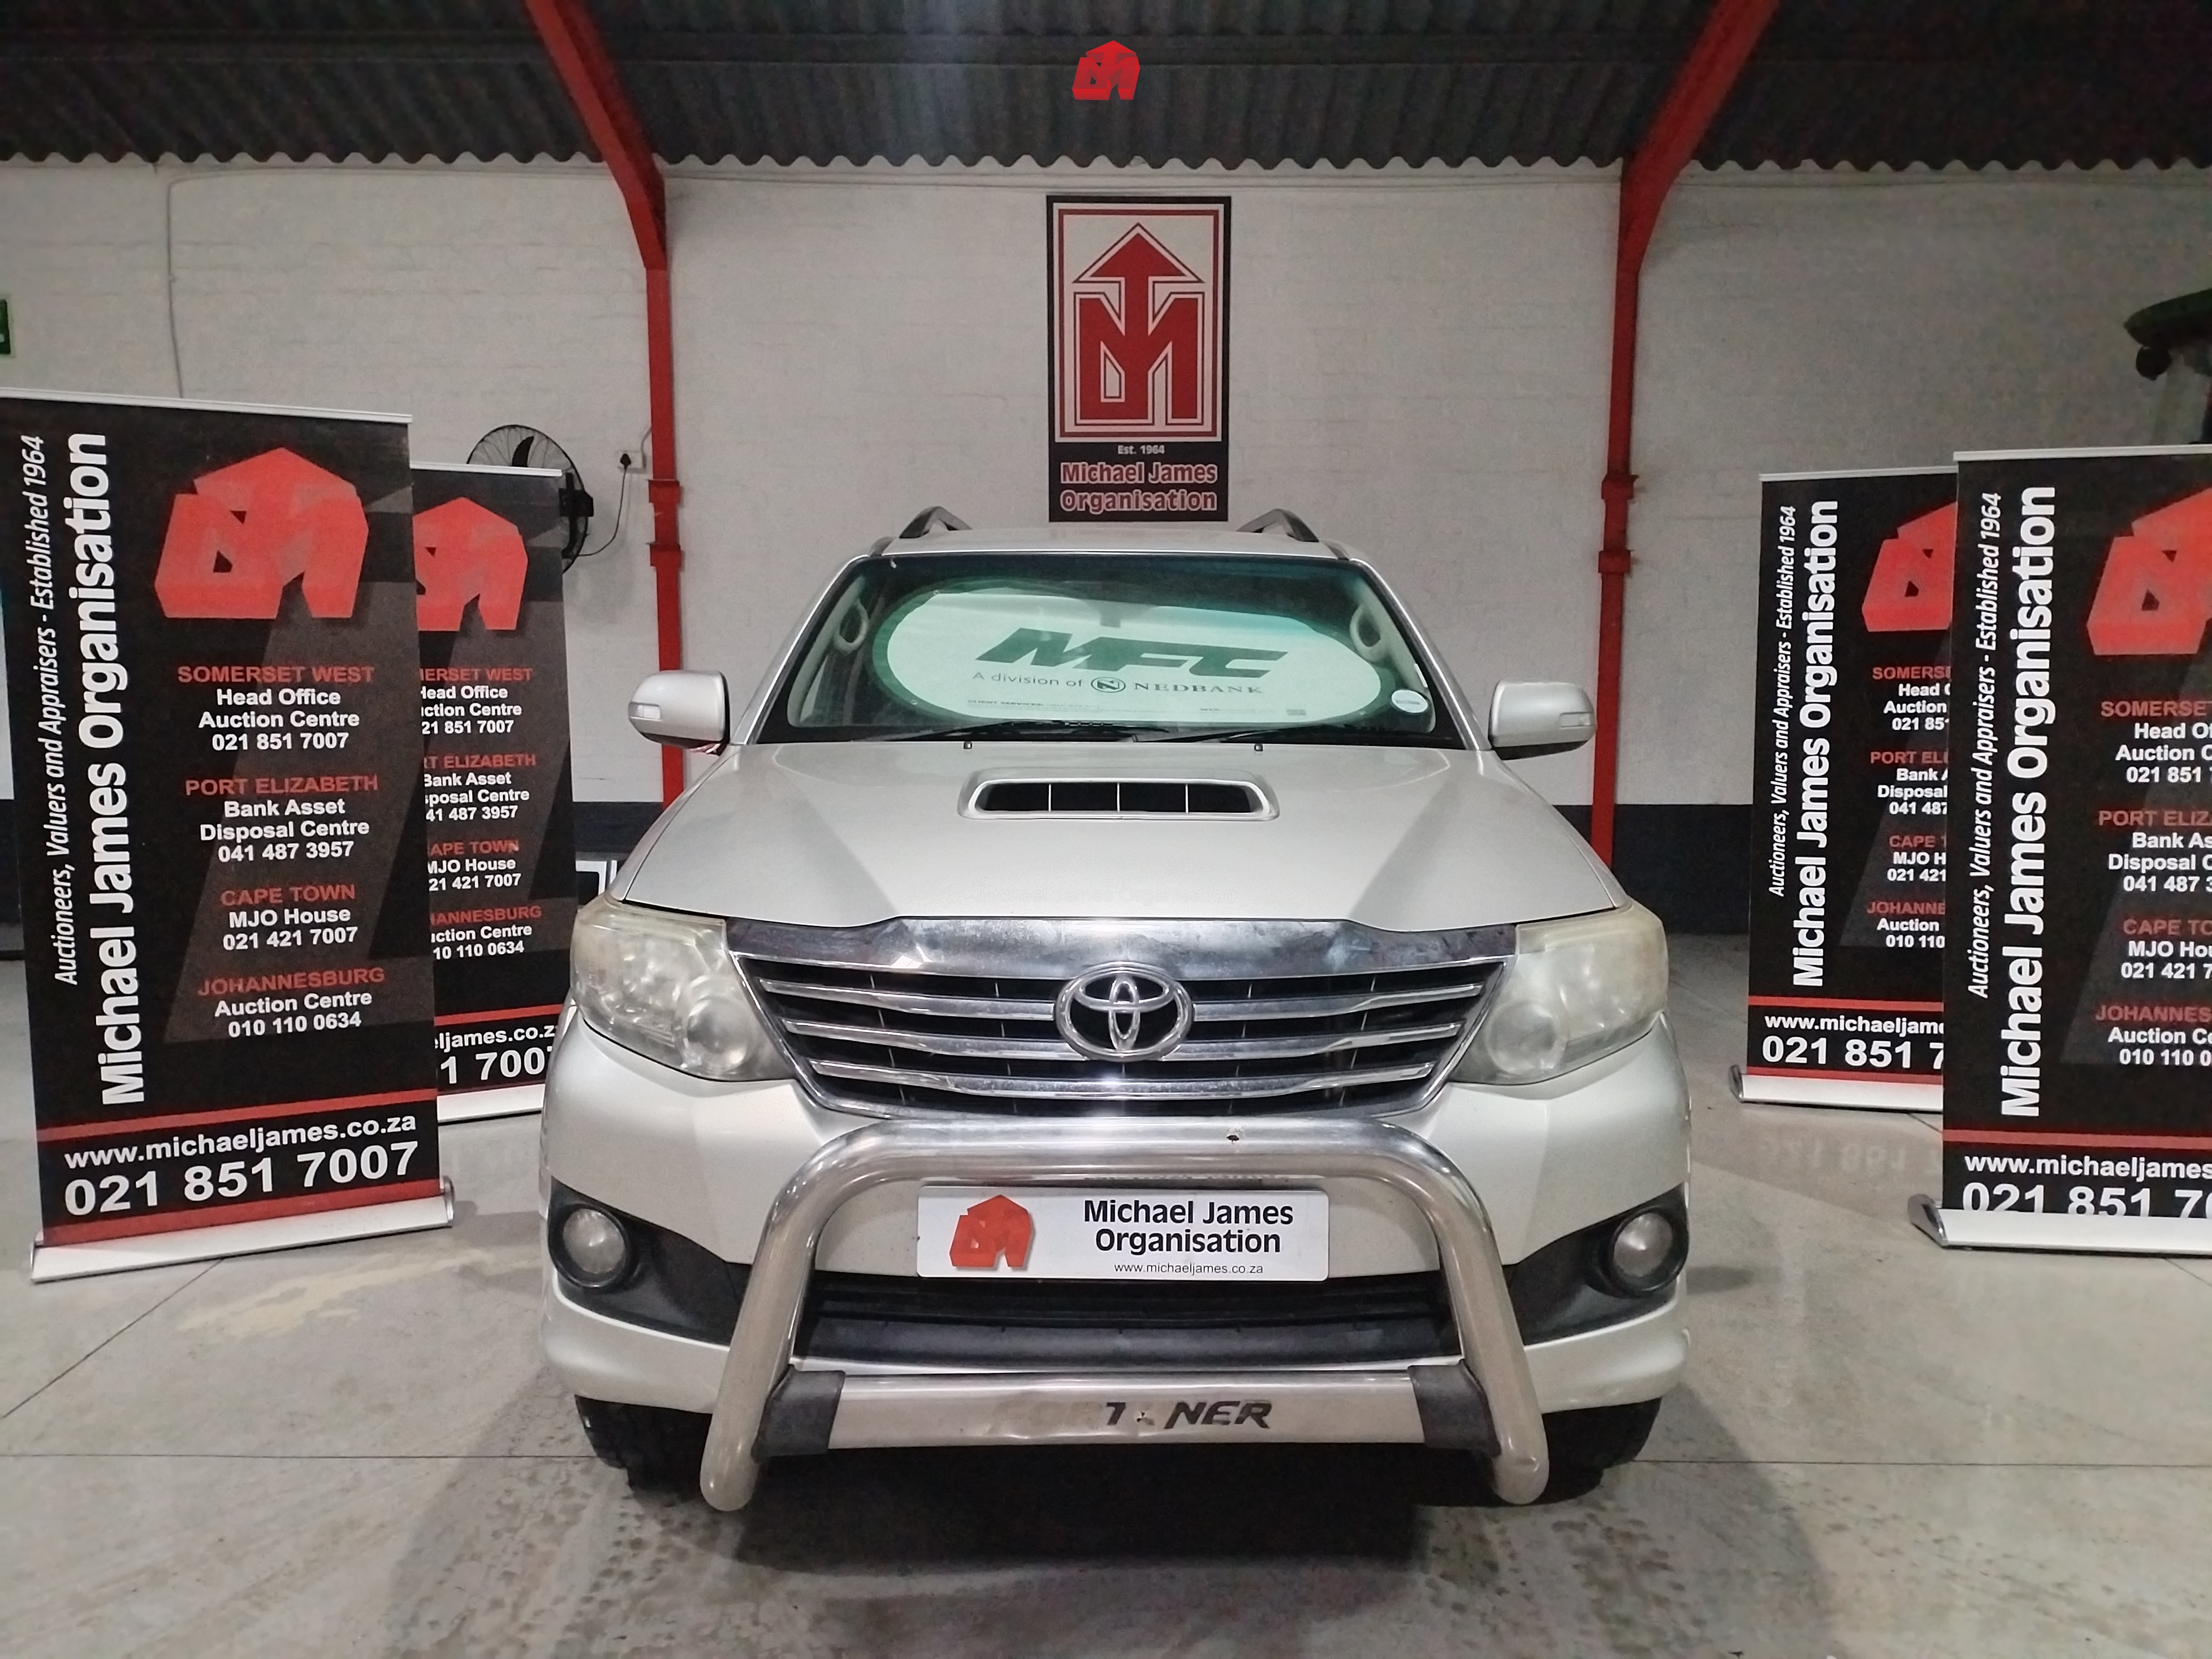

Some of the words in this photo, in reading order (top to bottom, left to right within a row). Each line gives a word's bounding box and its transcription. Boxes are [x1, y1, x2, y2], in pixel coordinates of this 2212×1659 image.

[1118, 446, 1136, 454] Est.
[1141, 445, 1164, 454] 1964
[21, 435, 46, 485] 1964
[1061, 462, 1144, 484] Michael
[1149, 462, 1217, 483] James
[1060, 489, 1217, 515] Organisation
[1779, 507, 1796, 542] 1964
[1980, 493, 2001, 538] 1964
[23, 491, 53, 609] Established
[64, 434, 127, 748] Organisation
[1776, 546, 1794, 629] Established
[1975, 544, 1999, 650] Established
[1800, 501, 1837, 727] Organisation
[2007, 488, 2055, 778] Organisation
[974, 628, 1287, 679] MFC
[33, 627, 66, 734] Appraisers
[179, 666, 306, 683] SOMERSET
[312, 666, 374, 682] WEST
[486, 669, 531, 680] WEST
[992, 673, 1058, 685] division
[1135, 683, 1261, 693] NEDBANK
[1773, 642, 1793, 718] Appraisers
[217, 689, 272, 705] Head
[279, 689, 340, 705] Office
[461, 686, 508, 698] Office
[1899, 683, 1940, 696] Head
[470, 703, 522, 716] Centre
[1884, 700, 1947, 713] Auction
[1973, 667, 1998, 765] Appraisers
[199, 711, 283, 728] Auction
[291, 711, 359, 727] Centre
[445, 720, 471, 733] 851
[477, 720, 514, 733] 7007
[1892, 717, 1919, 730] 021
[213, 734, 247, 750] 021
[257, 733, 292, 750] 851
[300, 732, 349, 748] 7007
[1772, 720, 1788, 748] and
[2135, 723, 2186, 739] Head
[38, 738, 64, 777] and
[444, 754, 535, 768] ELIZABETH
[1871, 752, 1917, 764] PORT
[2115, 745, 2194, 760] Auction
[466, 772, 511, 785] Asset
[1770, 752, 1788, 804] Valuers
[1897, 768, 1938, 780] Bank
[2127, 767, 2159, 783] 021
[2168, 767, 2201, 783] 851
[186, 778, 248, 795] PORT
[255, 775, 377, 793] ELIZABETH
[1797, 738, 1829, 847] James
[1878, 785, 1947, 800] Disposal
[1971, 767, 1992, 804] and
[478, 789, 529, 802] Centre
[225, 800, 279, 817] Bank
[285, 799, 345, 815] Asset
[449, 807, 477, 820] 487
[482, 805, 518, 819] 3957
[1890, 802, 1916, 814] 041
[1922, 802, 1947, 814] 487
[44, 783, 69, 855] Valuers
[2099, 811, 2158, 826] PORT
[88, 763, 133, 913] James
[200, 821, 294, 843] Disposal
[301, 820, 370, 837] Centre
[1890, 835, 1935, 847] CAPE
[2133, 832, 2183, 848] Bank
[219, 845, 253, 862] 041
[262, 844, 299, 860] 487
[306, 841, 354, 858] 3957
[470, 840, 519, 853] TOWN
[1769, 810, 1789, 896] Auctioneers,
[1969, 810, 1991, 876] Valuers
[466, 859, 515, 871] House
[1893, 852, 1930, 865] MJO
[2005, 792, 2046, 934] James
[2109, 854, 2195, 873] Disposal
[452, 876, 478, 889] 421
[485, 873, 521, 887] 7007
[1887, 868, 1913, 881] 021
[1919, 869, 1946, 881] 421
[2123, 876, 2156, 891] 041
[2164, 876, 2200, 892] 487
[221, 888, 282, 906] CAPE
[289, 885, 355, 901] TOWN
[51, 864, 77, 985] Auctioneers,
[230, 910, 277, 928] MJO
[285, 908, 350, 925] House
[1793, 857, 1826, 986] Michael
[1877, 918, 1939, 931] Auction
[2124, 919, 2181, 935] CAPE
[224, 933, 258, 950] 021
[267, 930, 301, 947] 421
[310, 927, 358, 945] 7007
[481, 925, 532, 939] Centre
[1886, 935, 1914, 947] 010
[1919, 935, 1945, 948] 110
[1967, 885, 1994, 998] Auctioneers,
[457, 944, 483, 957] 110
[488, 941, 524, 955] 0634
[2129, 941, 2173, 956] MJO
[2121, 962, 2153, 978] 021
[2161, 963, 2194, 979] 421
[198, 968, 384, 995] JOHANNESBURG
[215, 997, 297, 1017] Auction
[305, 992, 372, 1009] Centre
[90, 927, 144, 1104] Michael
[228, 1020, 265, 1037] 010
[273, 1016, 307, 1034] 110
[314, 1011, 361, 1030] 0634
[2000, 947, 2042, 1116] Michael
[2108, 1027, 2186, 1043] Auction
[1763, 1036, 1826, 1064] 021
[1845, 1040, 1911, 1068] 851
[2120, 1049, 2154, 1064] 010
[2161, 1049, 2194, 1065] 110
[476, 1046, 552, 1080] 700
[65, 1116, 416, 1169] www.michaeljames.co.za
[65, 1171, 157, 1215] 021
[185, 1157, 272, 1201] 851
[298, 1141, 417, 1187] 7007
[1963, 1183, 2045, 1213] 021
[2068, 1186, 2150, 1217] 851
[1085, 1200, 1193, 1223] Michael
[1203, 1202, 1293, 1224] James
[1096, 1229, 1280, 1255] Organisation
[1115, 1263, 1263, 1276] www.michaeljames.co.za
